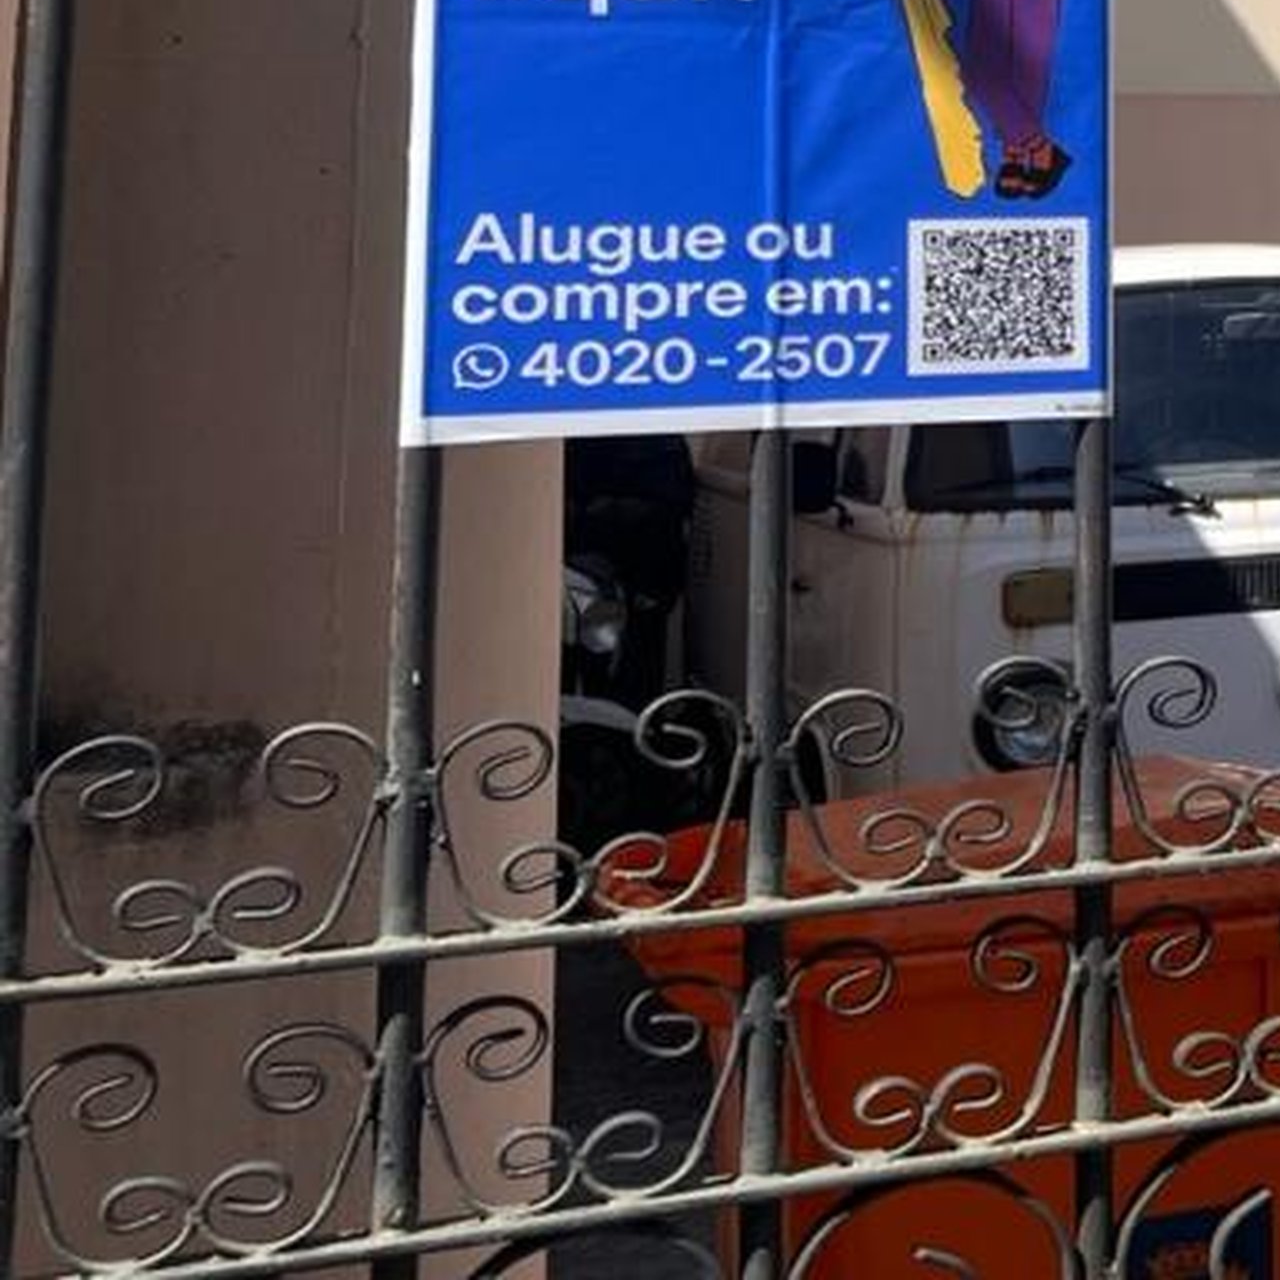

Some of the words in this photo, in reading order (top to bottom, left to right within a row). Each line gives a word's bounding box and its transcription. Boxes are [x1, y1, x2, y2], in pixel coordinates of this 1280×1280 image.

[455, 213, 726, 275] Alugue
[746, 224, 832, 261] ou
[452, 280, 747, 332] compre
[766, 275, 892, 315] em:
